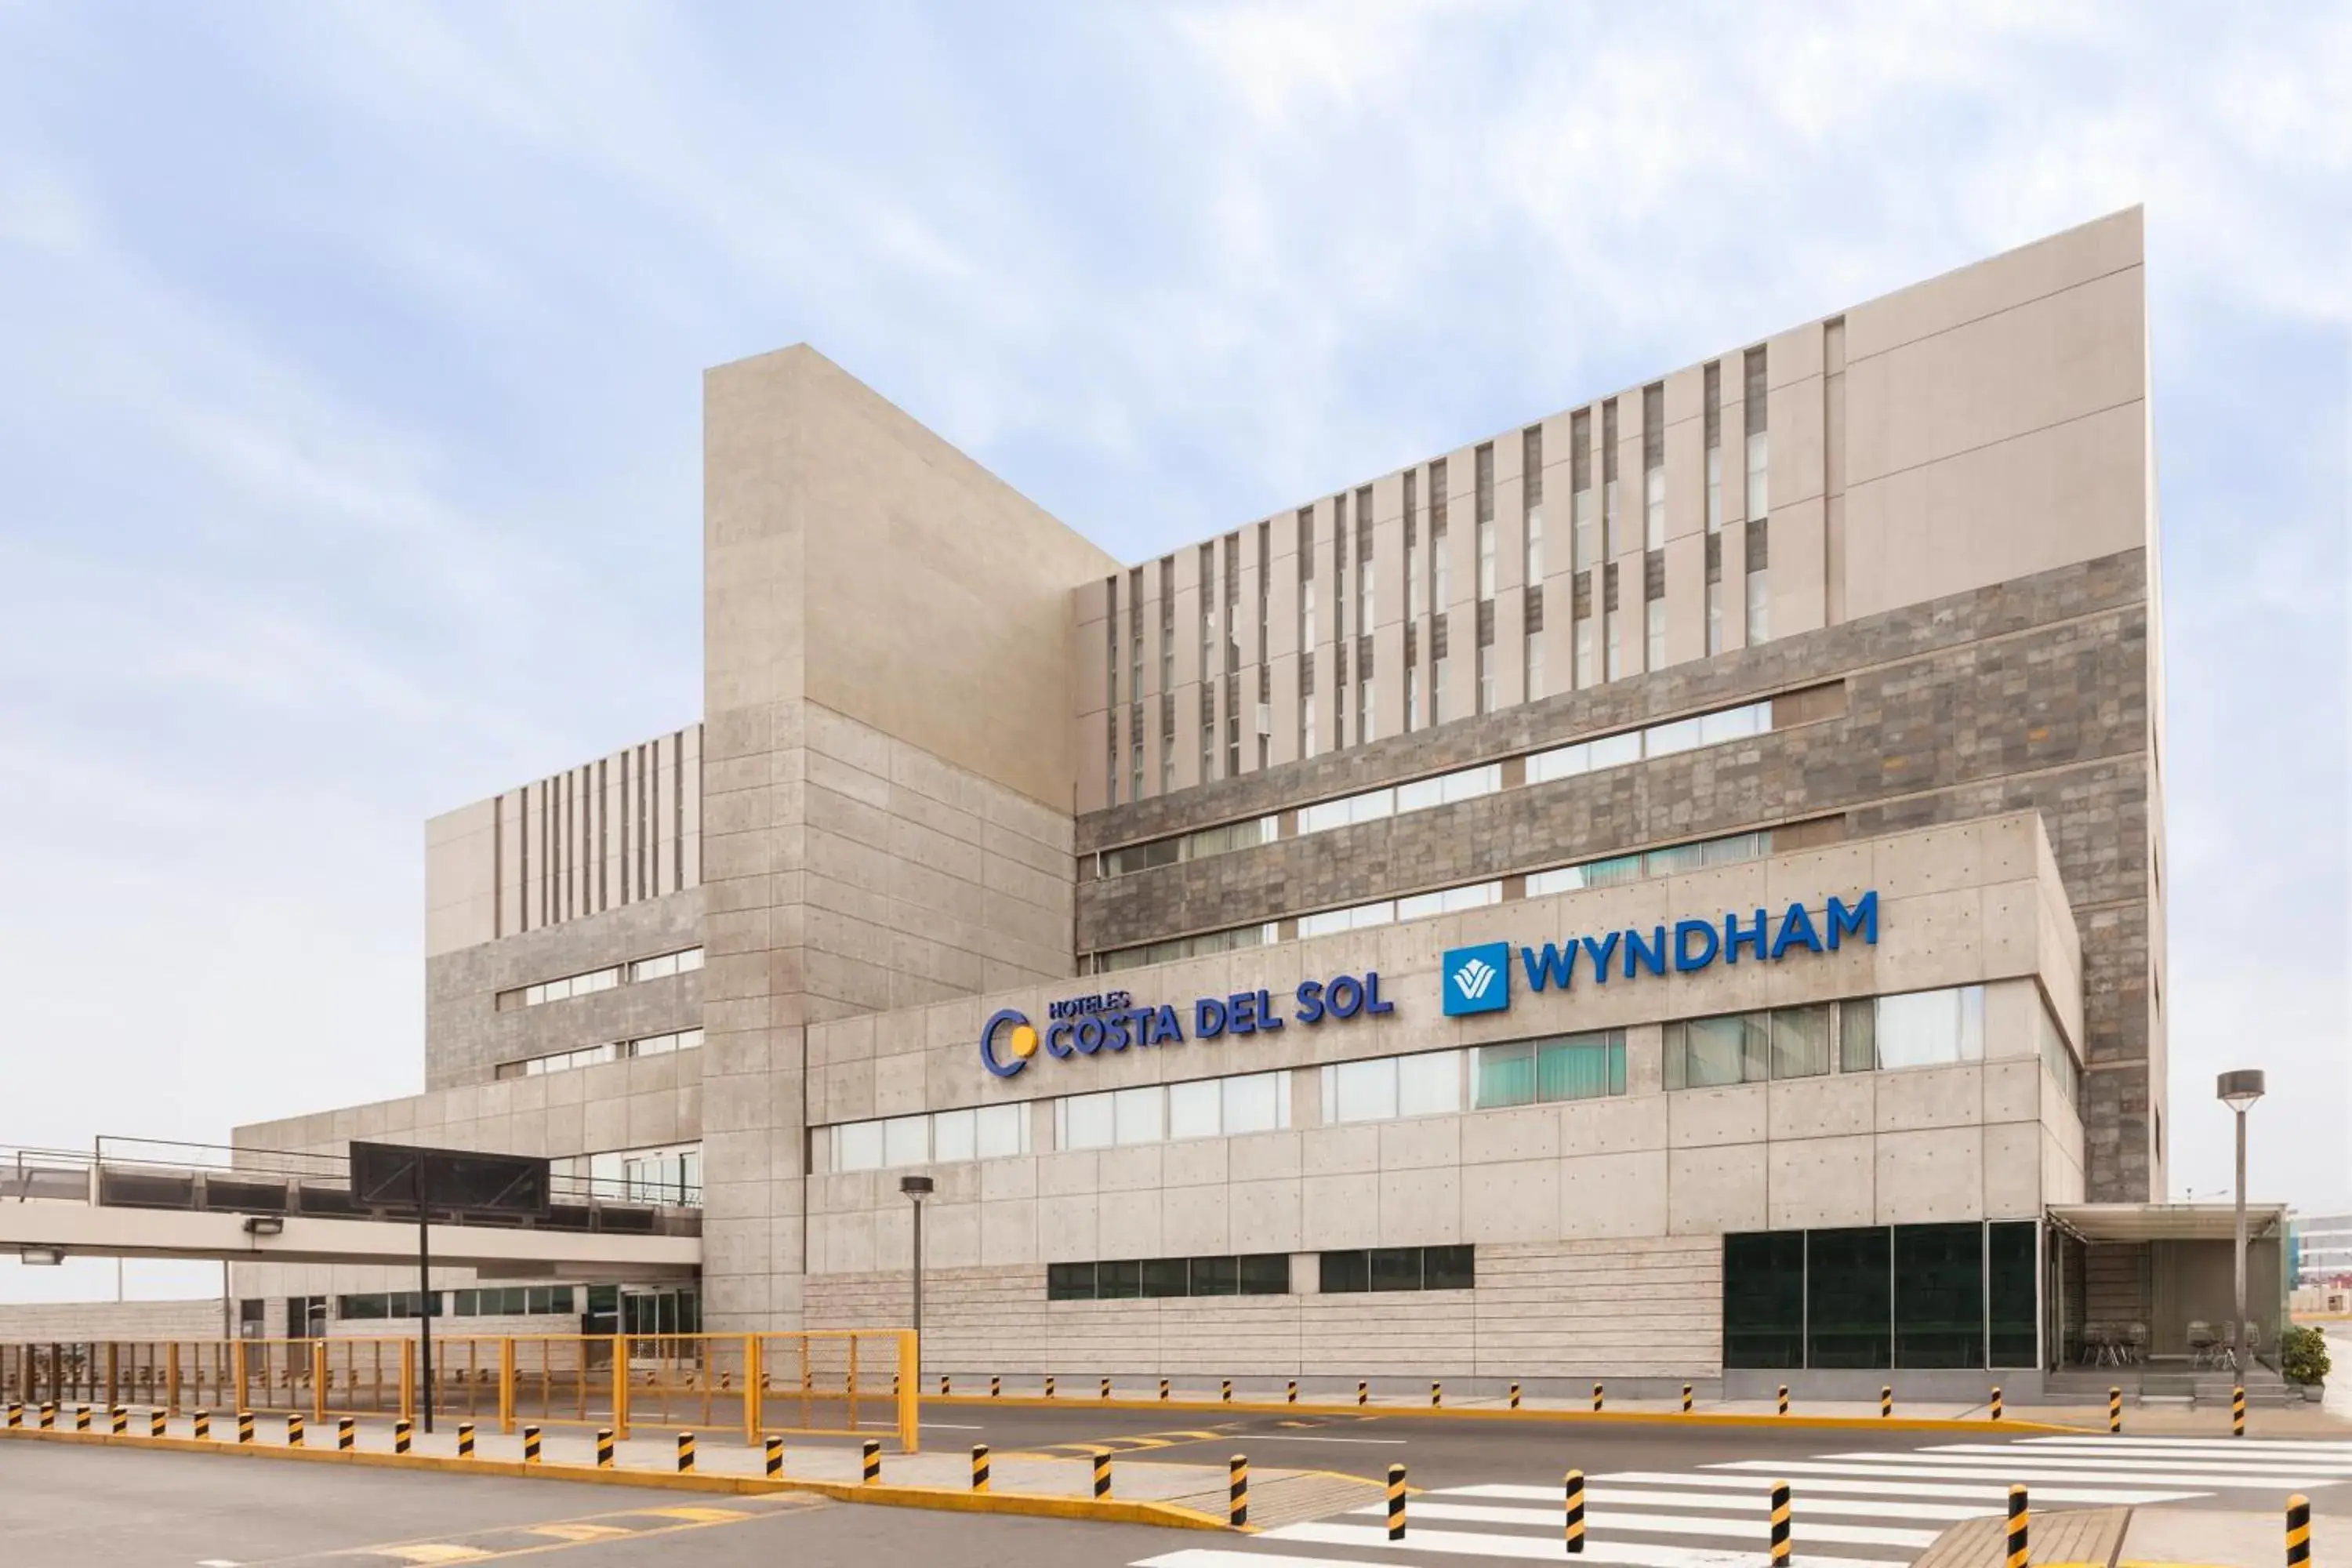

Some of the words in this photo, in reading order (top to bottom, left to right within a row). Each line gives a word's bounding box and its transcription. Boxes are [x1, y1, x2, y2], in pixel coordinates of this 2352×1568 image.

[1522, 891, 1878, 992] WYNDHAM
[1045, 1004, 1184, 1058] COSTA
[1196, 989, 1283, 1040] DEL
[1296, 971, 1395, 1023] SOL
[1049, 990, 1131, 1019] HOTELES
